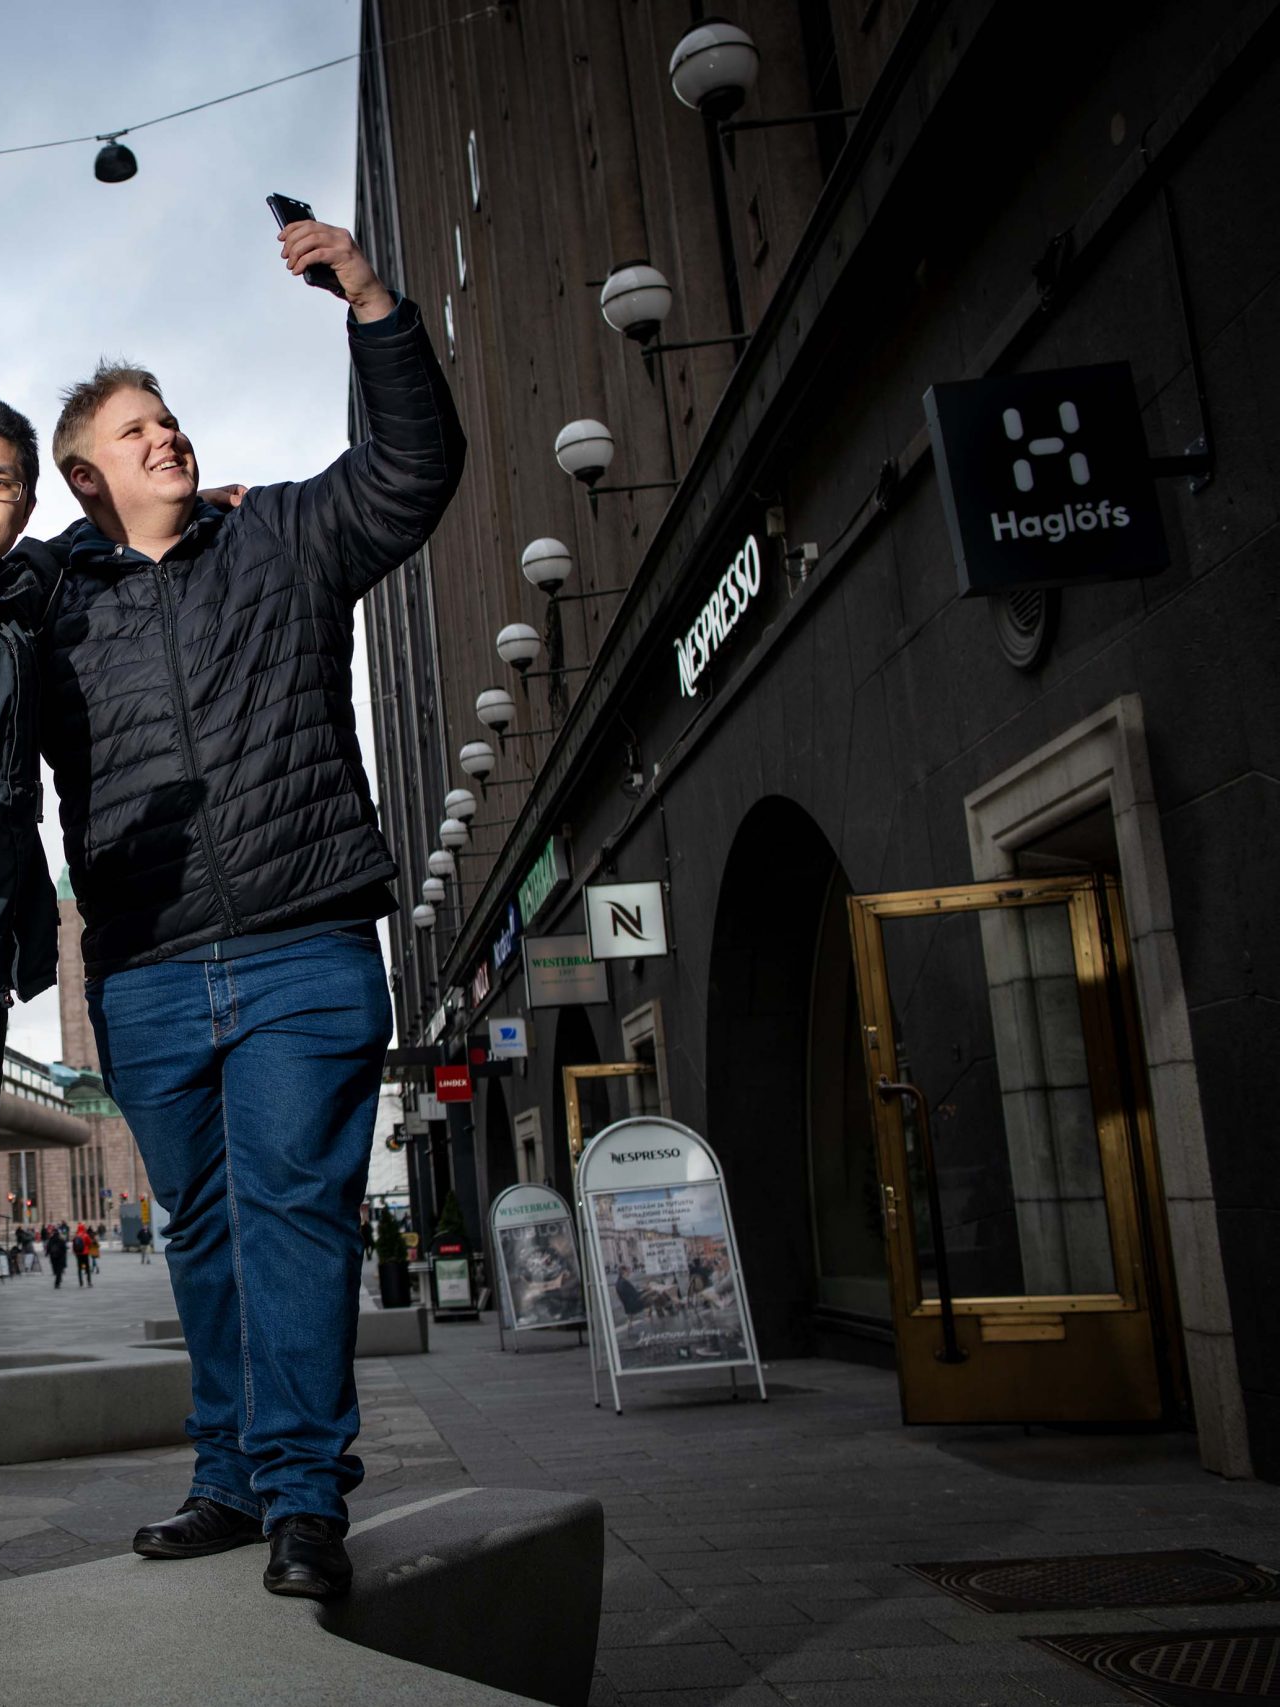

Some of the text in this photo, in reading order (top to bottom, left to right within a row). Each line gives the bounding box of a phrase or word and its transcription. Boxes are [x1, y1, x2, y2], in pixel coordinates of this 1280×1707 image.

[990, 500, 1131, 543] Haglöfs
[674, 534, 761, 697] NESPRESSO
[610, 1148, 680, 1165] NESPRESSO
[500, 1201, 560, 1216] WESTERBACK
